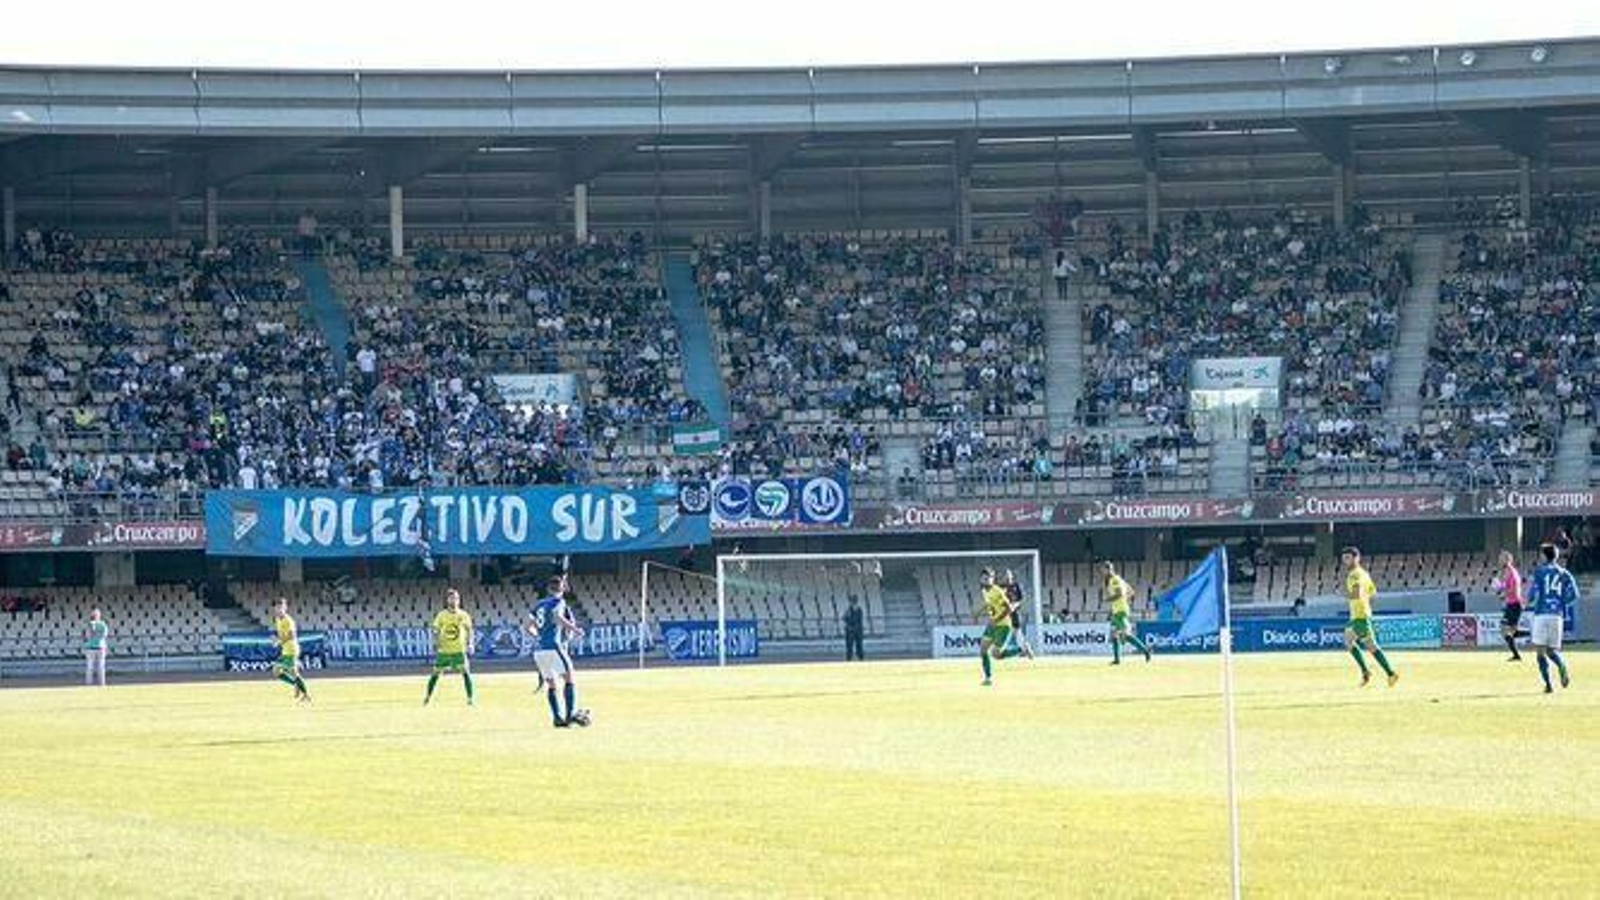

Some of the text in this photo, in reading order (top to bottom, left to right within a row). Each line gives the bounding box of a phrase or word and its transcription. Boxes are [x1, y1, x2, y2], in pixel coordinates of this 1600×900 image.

[1306, 495, 1393, 515] Cruzcampo
[1508, 490, 1594, 510] Cruzcampo
[552, 493, 641, 543] SUR
[905, 506, 991, 526] Cruzcampo
[1106, 501, 1191, 521] Cruzcampo
[113, 522, 198, 546] Cruzcampo
[1543, 572, 1563, 597] 14
[1043, 629, 1106, 645] helvetia
[1262, 628, 1345, 646] Diario de Jere
